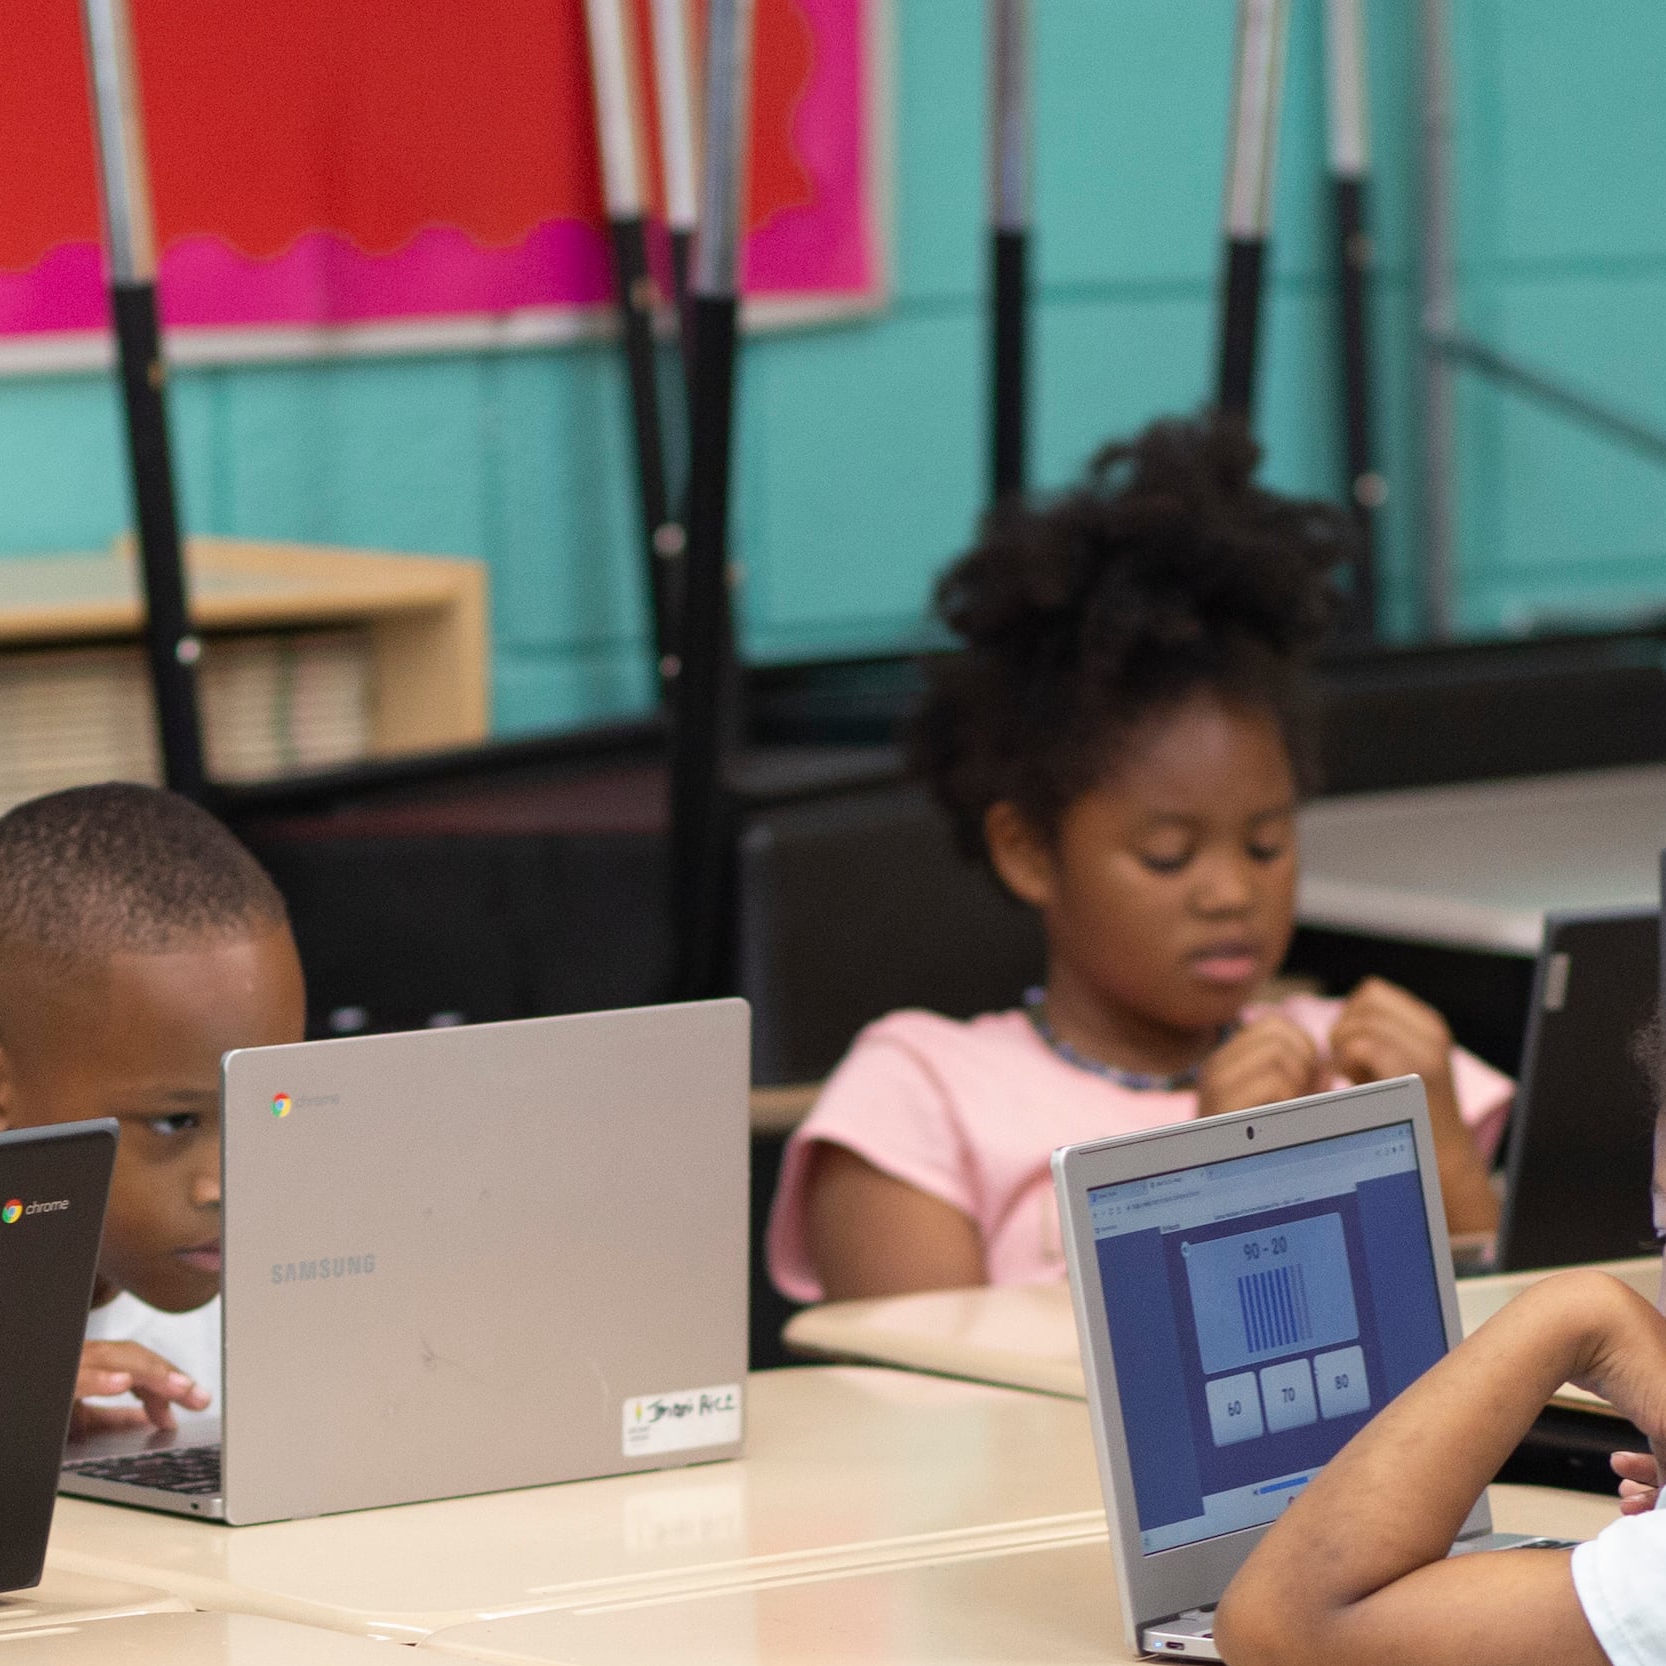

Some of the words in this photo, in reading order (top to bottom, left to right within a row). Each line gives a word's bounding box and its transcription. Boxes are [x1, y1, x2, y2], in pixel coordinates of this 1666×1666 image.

[25, 1200, 70, 1215] chrome
[1243, 1242, 1260, 1261] 90
[1271, 1236, 1288, 1256] 20
[271, 1254, 375, 1285] SAMSUNG
[1227, 1400, 1242, 1417] 60
[1281, 1387, 1296, 1404] 70
[1334, 1373, 1350, 1390] 80
